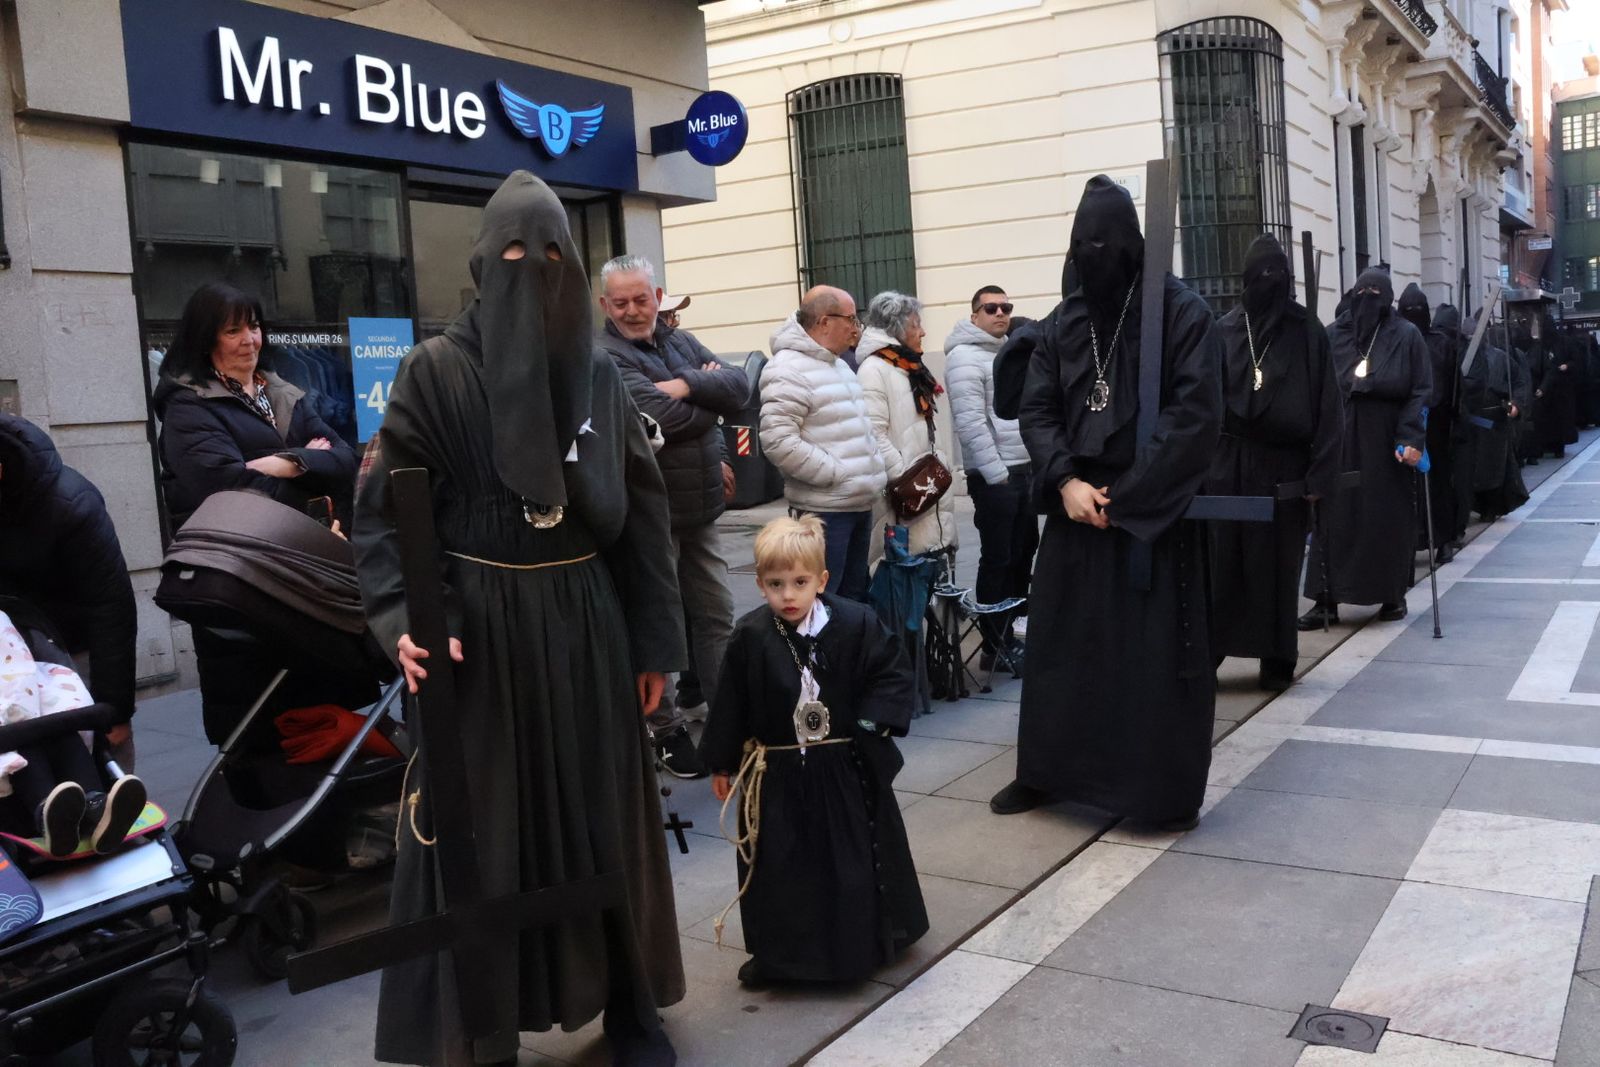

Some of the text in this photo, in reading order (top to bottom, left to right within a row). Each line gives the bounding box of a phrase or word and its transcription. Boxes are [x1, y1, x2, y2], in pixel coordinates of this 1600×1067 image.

[218, 26, 486, 139] Mr. Blue
[547, 111, 564, 141] B
[688, 113, 738, 134] Mr. Blue
[267, 333, 343, 345] RING SUMMER 26
[354, 345, 411, 359] CAMISAS
[358, 381, 394, 414] -4
